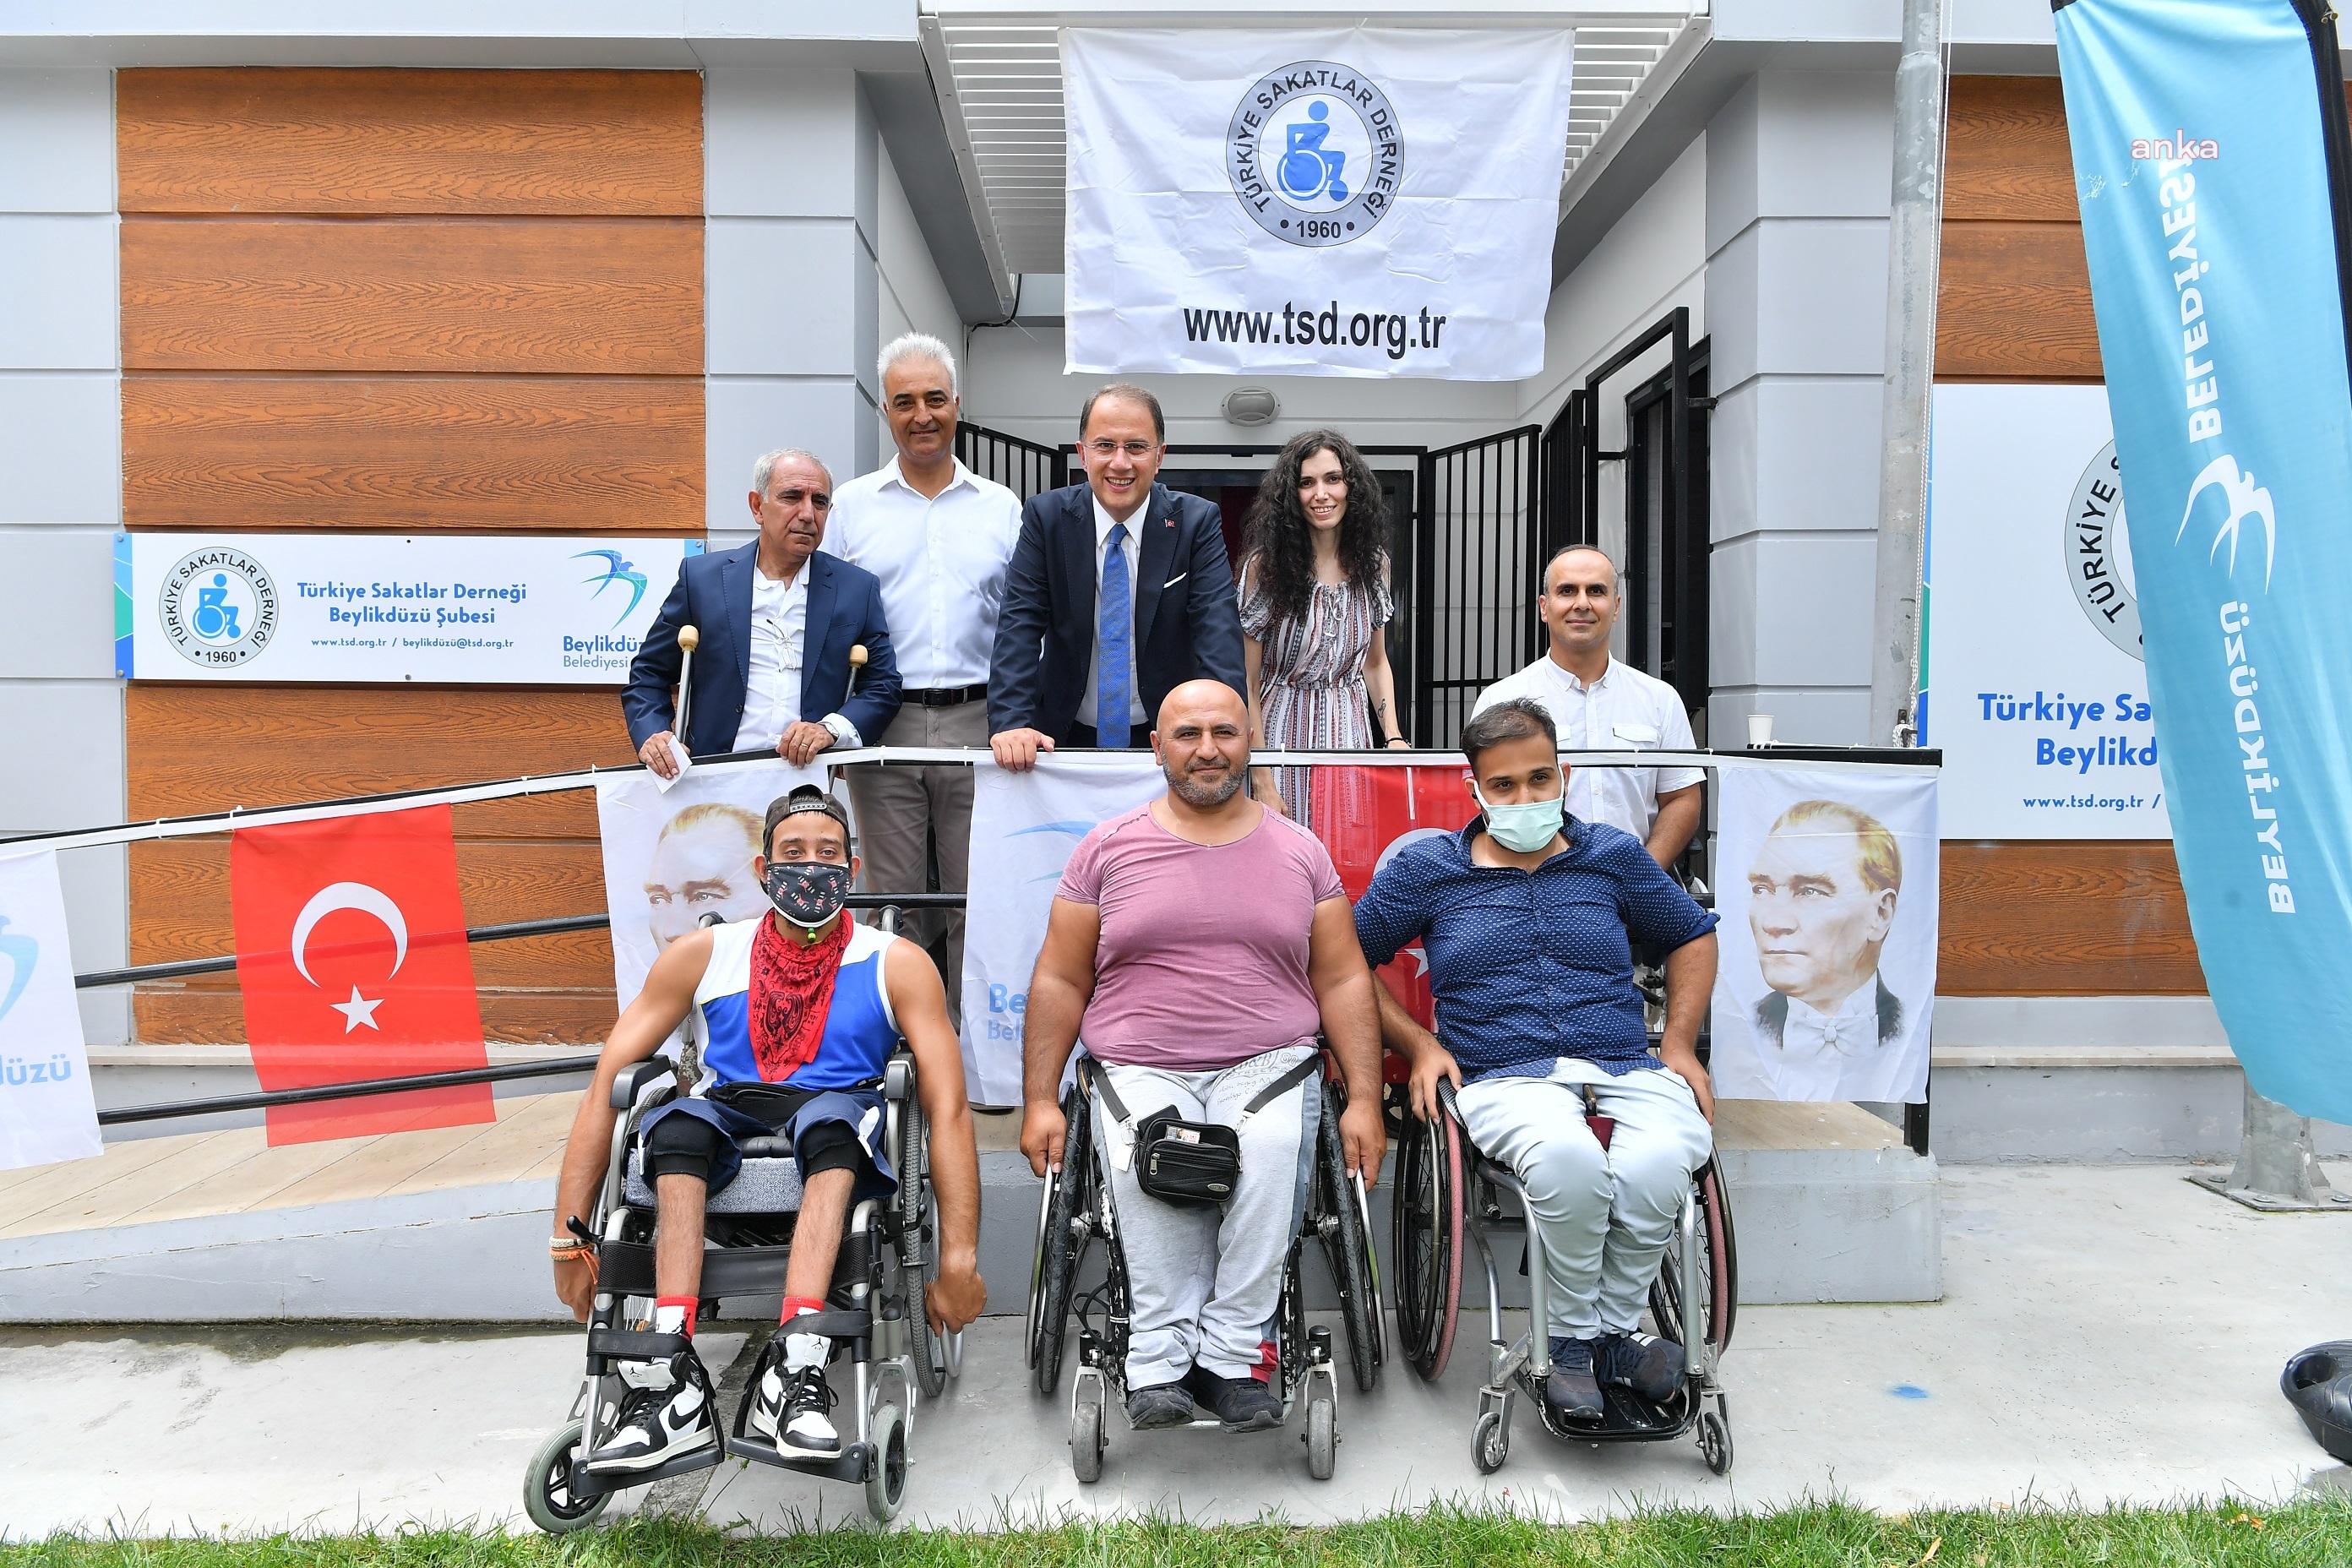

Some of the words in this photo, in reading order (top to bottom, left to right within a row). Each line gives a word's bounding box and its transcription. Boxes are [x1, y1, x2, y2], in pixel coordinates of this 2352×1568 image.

[1233, 111, 1271, 213] TÜRKİYE
[1257, 70, 1373, 110] SAKATLAR
[1362, 108, 1397, 219] DERNEĞİ
[1296, 220, 1342, 239] 1960
[1184, 300, 1446, 360] www.tsd.org.tr
[2076, 479, 2126, 624] TÜRKİYE
[164, 579, 188, 646] TÜRKİYE
[179, 553, 257, 578] SAKATLAR
[251, 577, 274, 648] DERNEĞİ
[297, 581, 367, 602] Türkiye
[371, 581, 448, 599] Sakatlar
[454, 583, 527, 604] Derneği
[329, 606, 431, 627] Beylikdüzü
[437, 607, 495, 628] Şubesi
[311, 637, 387, 649] www.tsd.org.tr
[402, 637, 514, 650] beylikdüzü@tsd.org.tr
[563, 635, 645, 655] Beylikdü
[205, 651, 237, 662] 1960
[563, 654, 629, 672] Belediyesi
[1977, 691, 2105, 730] Türkiye
[2036, 736, 2159, 775] Beylikd
[2023, 794, 2144, 812] www.tsd.org.tr
